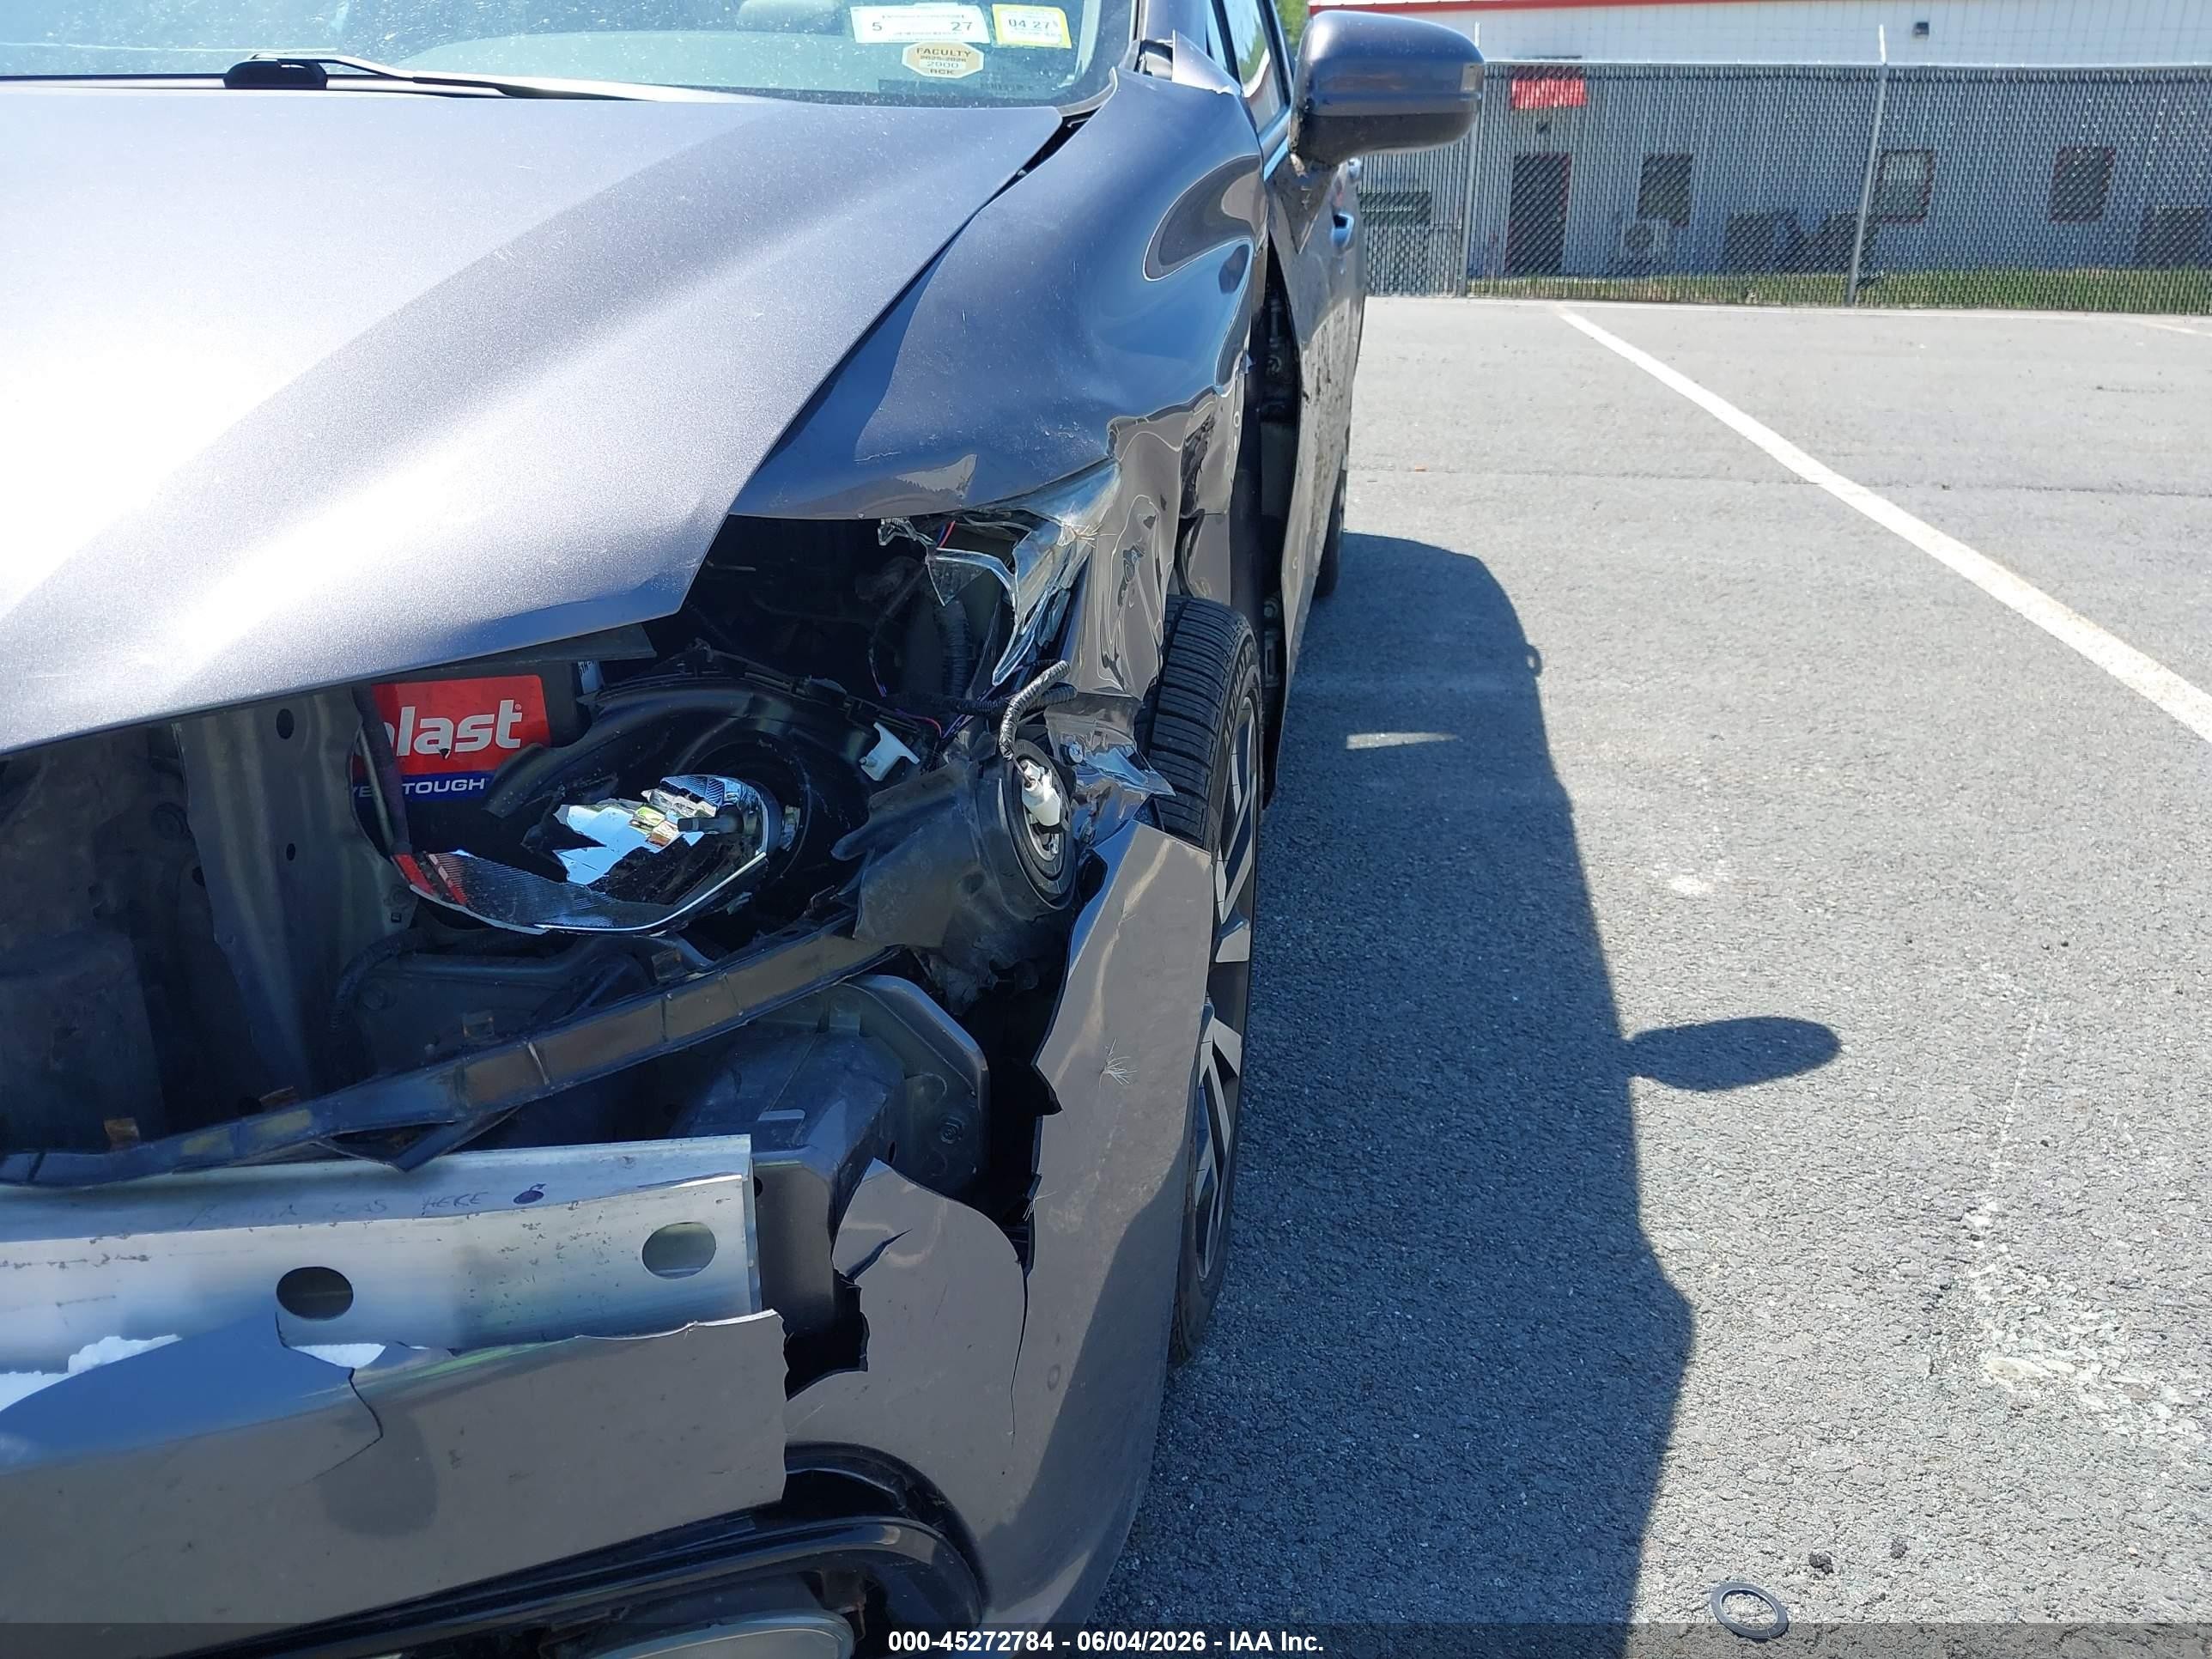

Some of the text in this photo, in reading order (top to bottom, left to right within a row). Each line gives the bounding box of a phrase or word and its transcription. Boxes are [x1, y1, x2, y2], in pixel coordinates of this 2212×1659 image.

[872, 21, 973, 32] 5 27
[1008, 19, 1050, 29] 04 27
[916, 47, 971, 58] FACULTY
[402, 778, 484, 795] TOUGH
